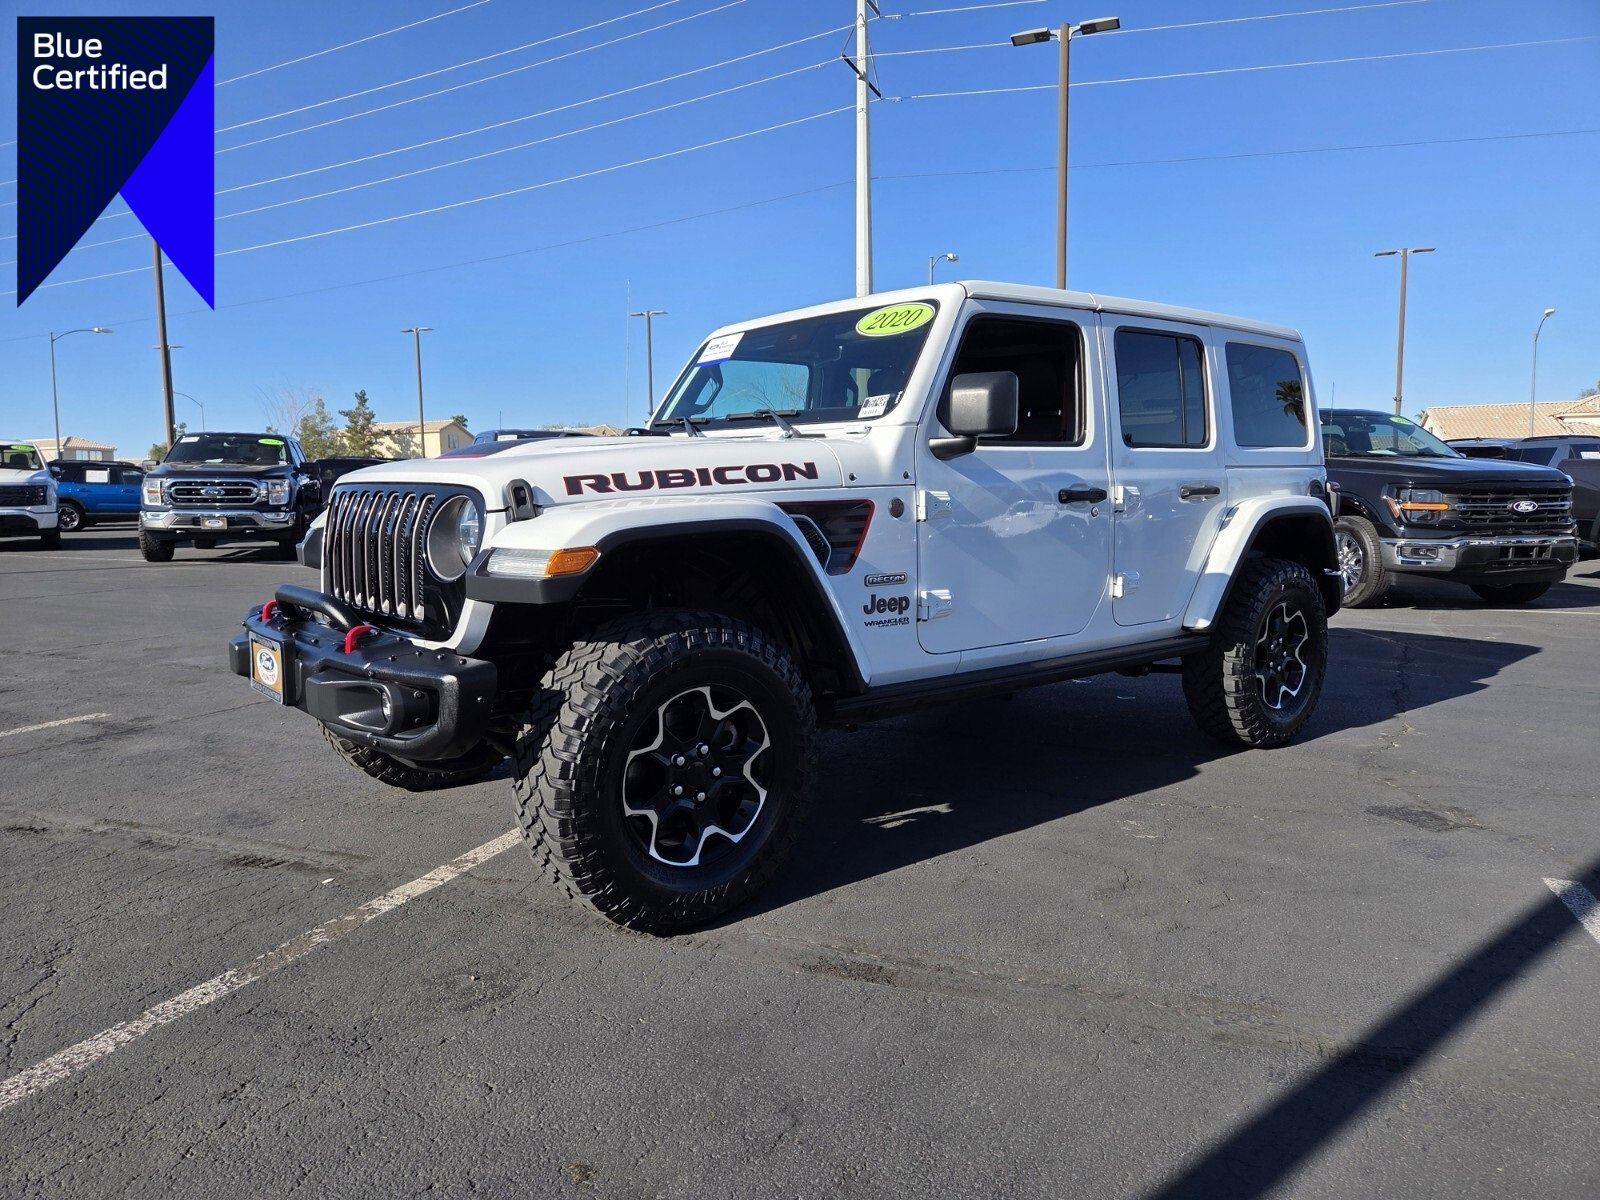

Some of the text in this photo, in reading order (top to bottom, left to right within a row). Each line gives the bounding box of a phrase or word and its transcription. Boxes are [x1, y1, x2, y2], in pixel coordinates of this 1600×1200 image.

[865, 308, 924, 330] 2020
[563, 461, 819, 496] RUBICON
[869, 575, 905, 584] RECON
[863, 594, 910, 615] Jeep
[864, 617, 909, 627] WRANGLER
